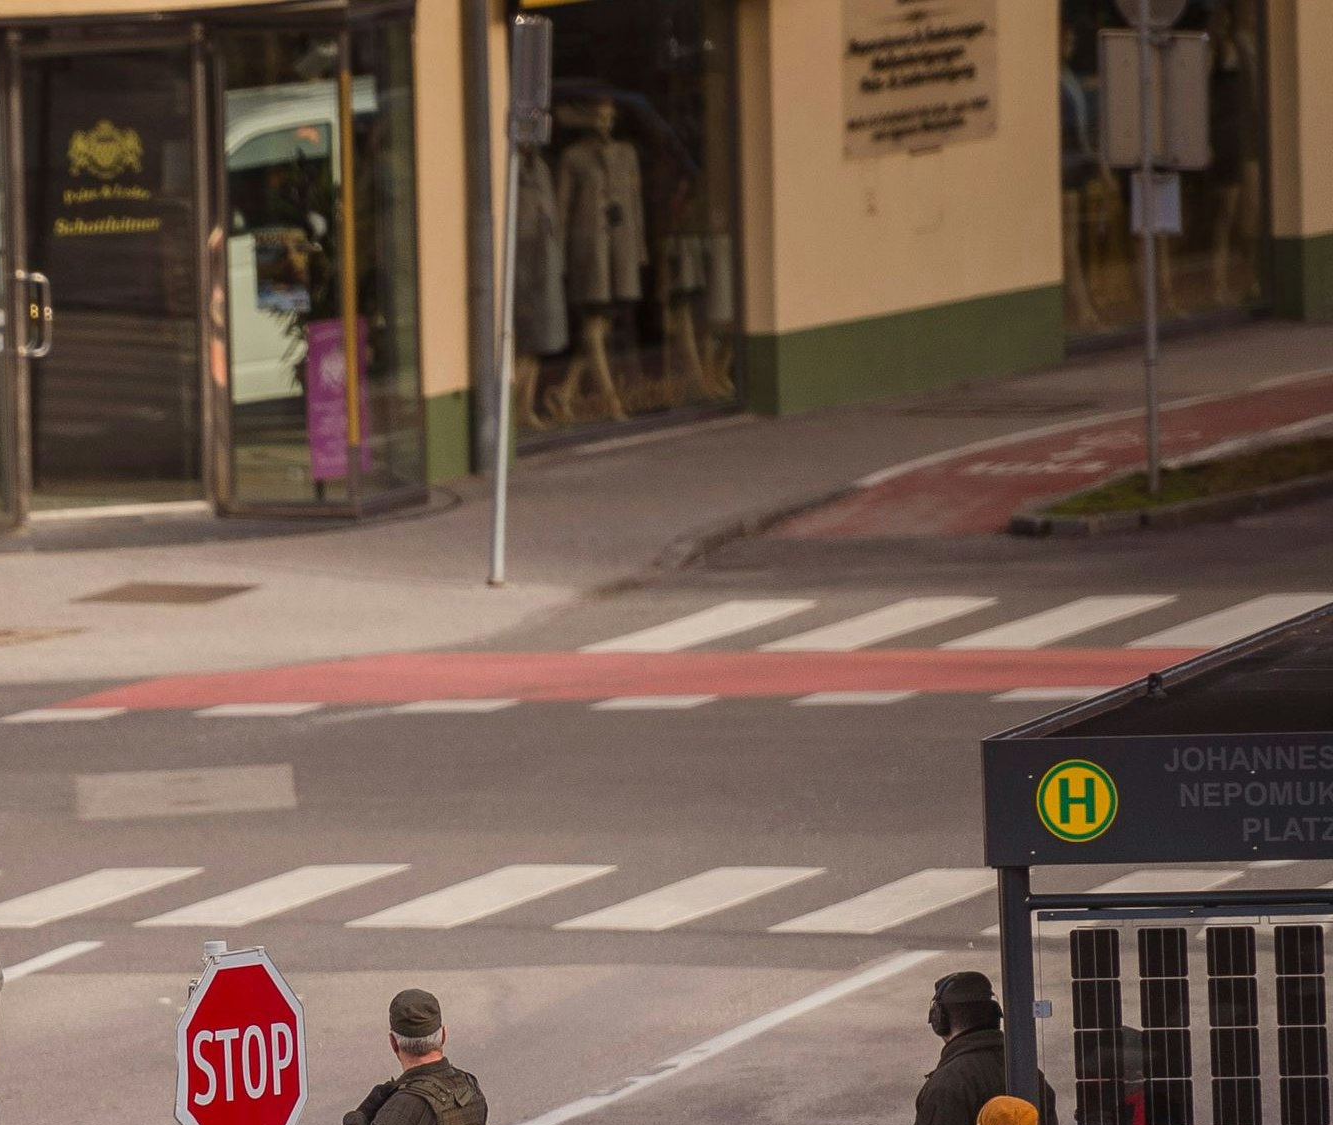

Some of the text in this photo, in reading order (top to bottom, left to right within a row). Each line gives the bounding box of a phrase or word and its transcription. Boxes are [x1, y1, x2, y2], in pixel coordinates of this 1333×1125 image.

[1164, 745, 1333, 772] JOHANNES
[1059, 777, 1096, 824] H
[1180, 781, 1333, 808] NEPOMUK
[192, 1022, 294, 1106] STOP
